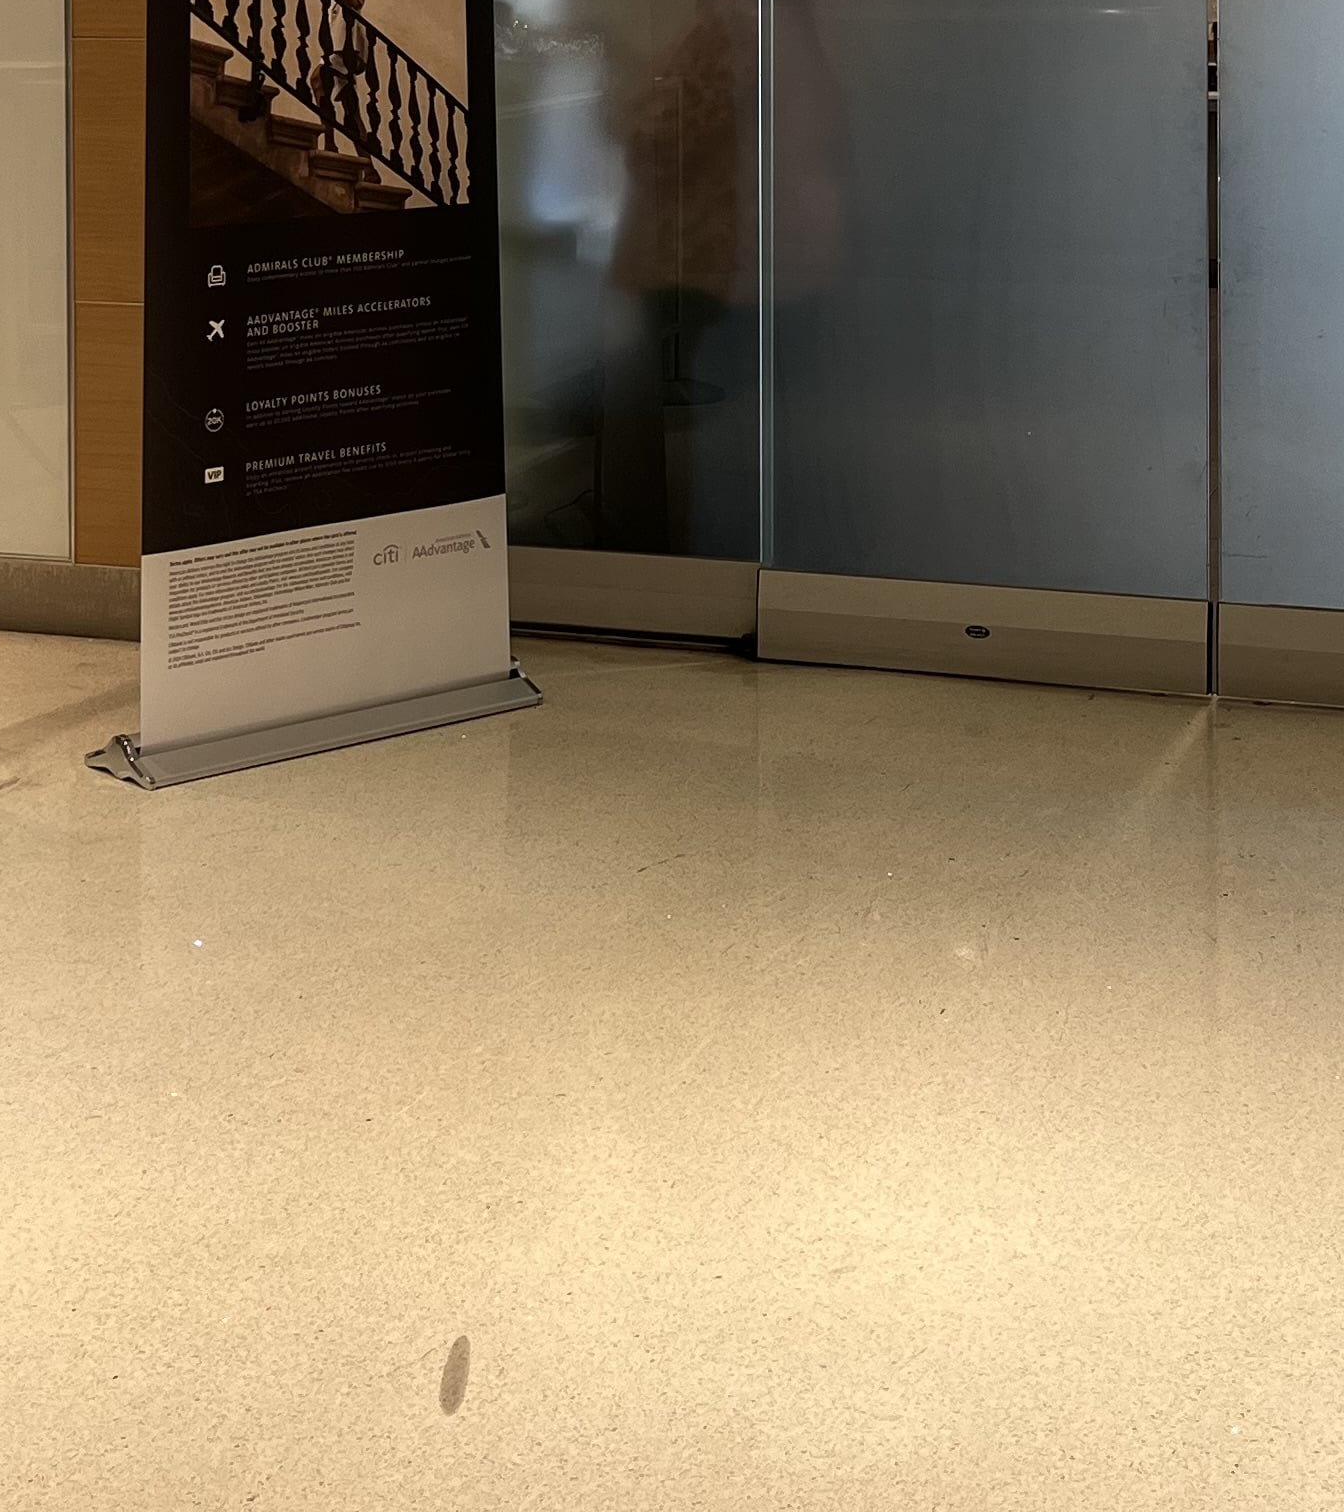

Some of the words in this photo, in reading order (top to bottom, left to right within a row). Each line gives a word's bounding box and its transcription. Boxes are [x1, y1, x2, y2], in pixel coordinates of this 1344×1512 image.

[247, 259, 298, 274] ADMIRALS
[336, 250, 405, 265] MEMBERSHIP
[323, 304, 354, 317] MILES
[357, 296, 431, 313] ACCELERATORS
[247, 326, 269, 337] AND
[273, 320, 319, 335] BOOSTER
[246, 397, 288, 412] LOYALTY
[291, 391, 330, 405] POINTS
[333, 384, 382, 399] BONUSES
[246, 455, 295, 472] PREMIUM
[299, 450, 336, 463] TRAVEL
[340, 442, 387, 458] BENEFITS
[207, 469, 222, 481] VIP
[373, 544, 400, 566] citi
[412, 539, 475, 559] AAdvantage
